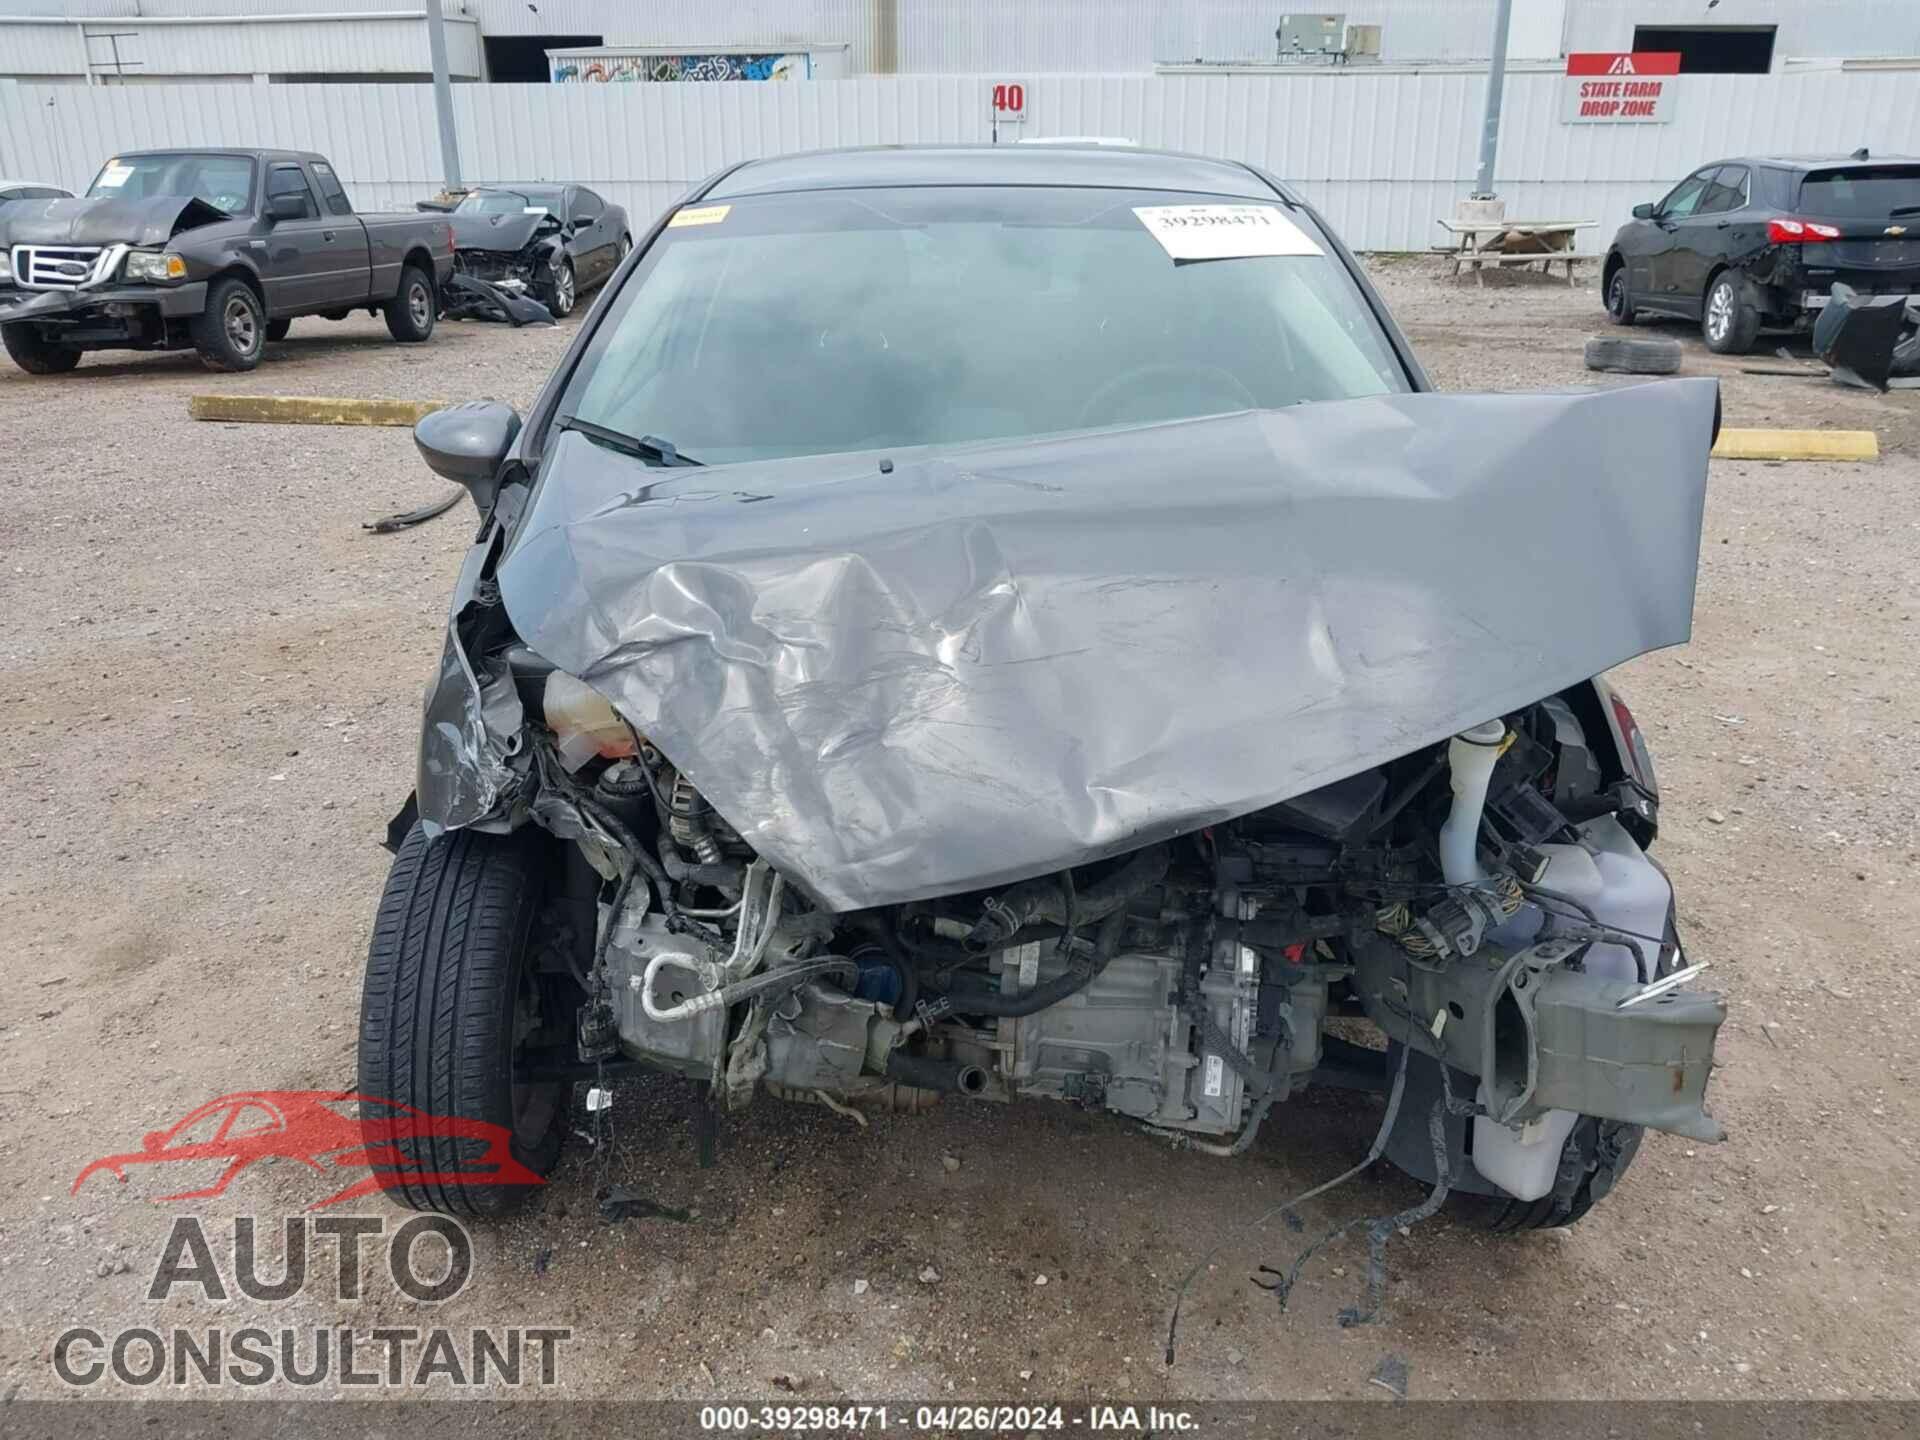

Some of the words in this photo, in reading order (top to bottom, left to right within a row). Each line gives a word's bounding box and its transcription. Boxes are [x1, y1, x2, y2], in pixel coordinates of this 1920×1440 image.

[992, 84, 1023, 111] 40
[1580, 81, 1622, 98] STATE
[1623, 81, 1663, 98] FARM
[1580, 100, 1620, 117] DROP
[1620, 100, 1657, 117] ZONE
[1159, 214, 1272, 229] 39298471
